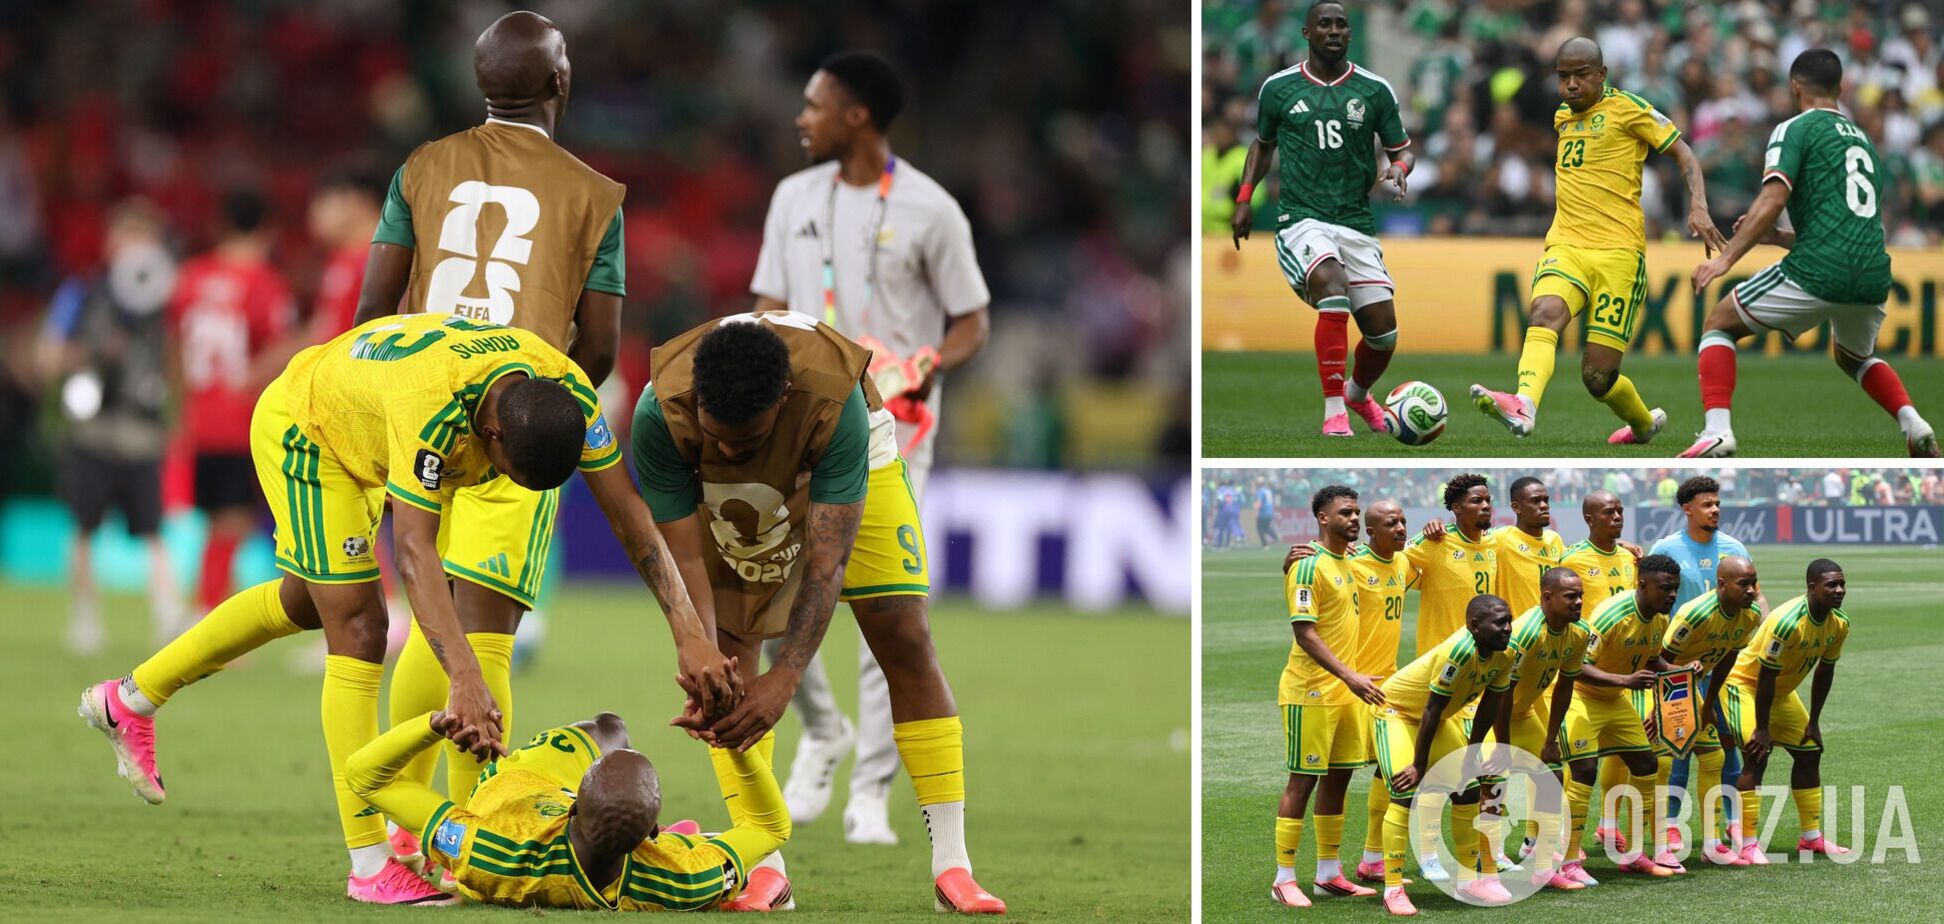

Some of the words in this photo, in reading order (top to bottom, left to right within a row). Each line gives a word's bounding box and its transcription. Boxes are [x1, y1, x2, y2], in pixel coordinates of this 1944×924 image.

[1314, 119, 1344, 150] 16
[1561, 139, 1586, 168] 23
[1845, 145, 1877, 218] 6
[454, 304, 491, 322] FIFA
[1594, 293, 1626, 327] 23
[450, 335, 520, 360] ADAMS
[1806, 509, 1938, 542] ULTRA
[770, 543, 802, 562] CUP
[897, 524, 923, 576] 9
[1475, 571, 1490, 595] 21
[1385, 596, 1402, 620] 20
